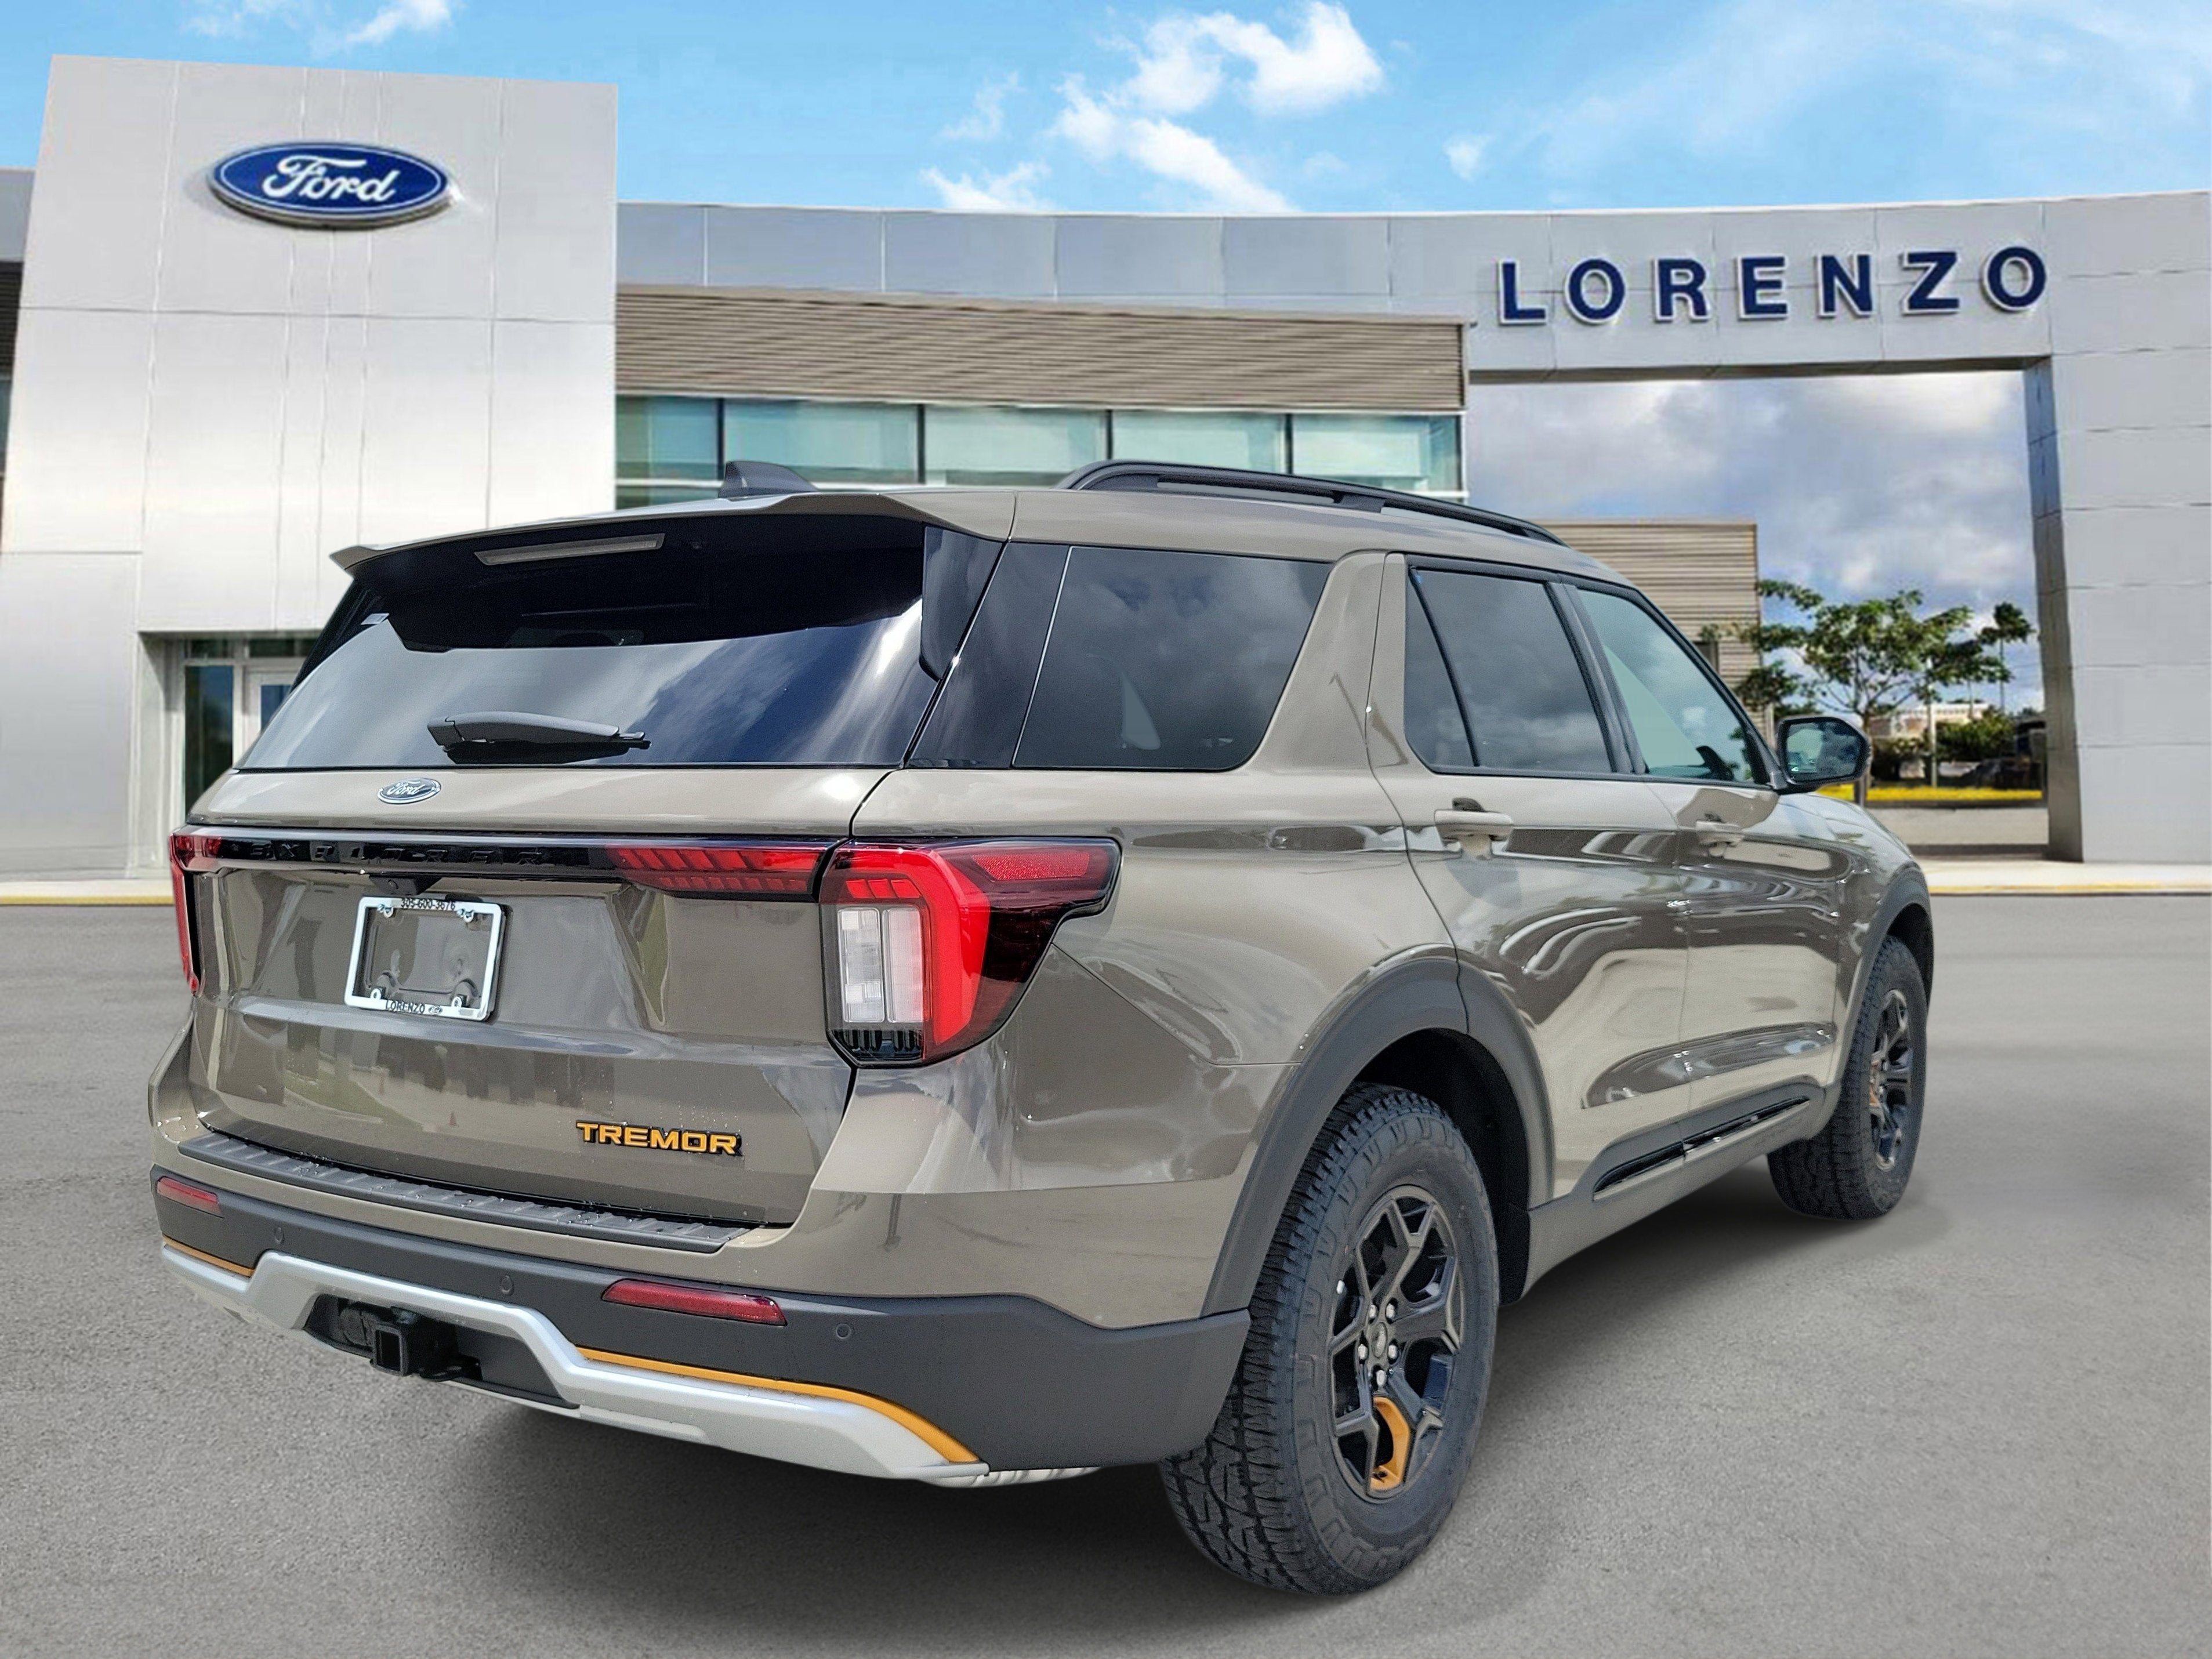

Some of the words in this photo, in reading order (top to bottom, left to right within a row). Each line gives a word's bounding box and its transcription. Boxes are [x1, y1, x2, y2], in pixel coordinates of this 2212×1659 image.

[262, 154, 401, 202] Ford
[1499, 245, 2047, 324] LORENZO
[386, 779, 426, 796] Ford
[385, 998, 426, 1015] LORENZO
[576, 1120, 742, 1156] TREMOR
